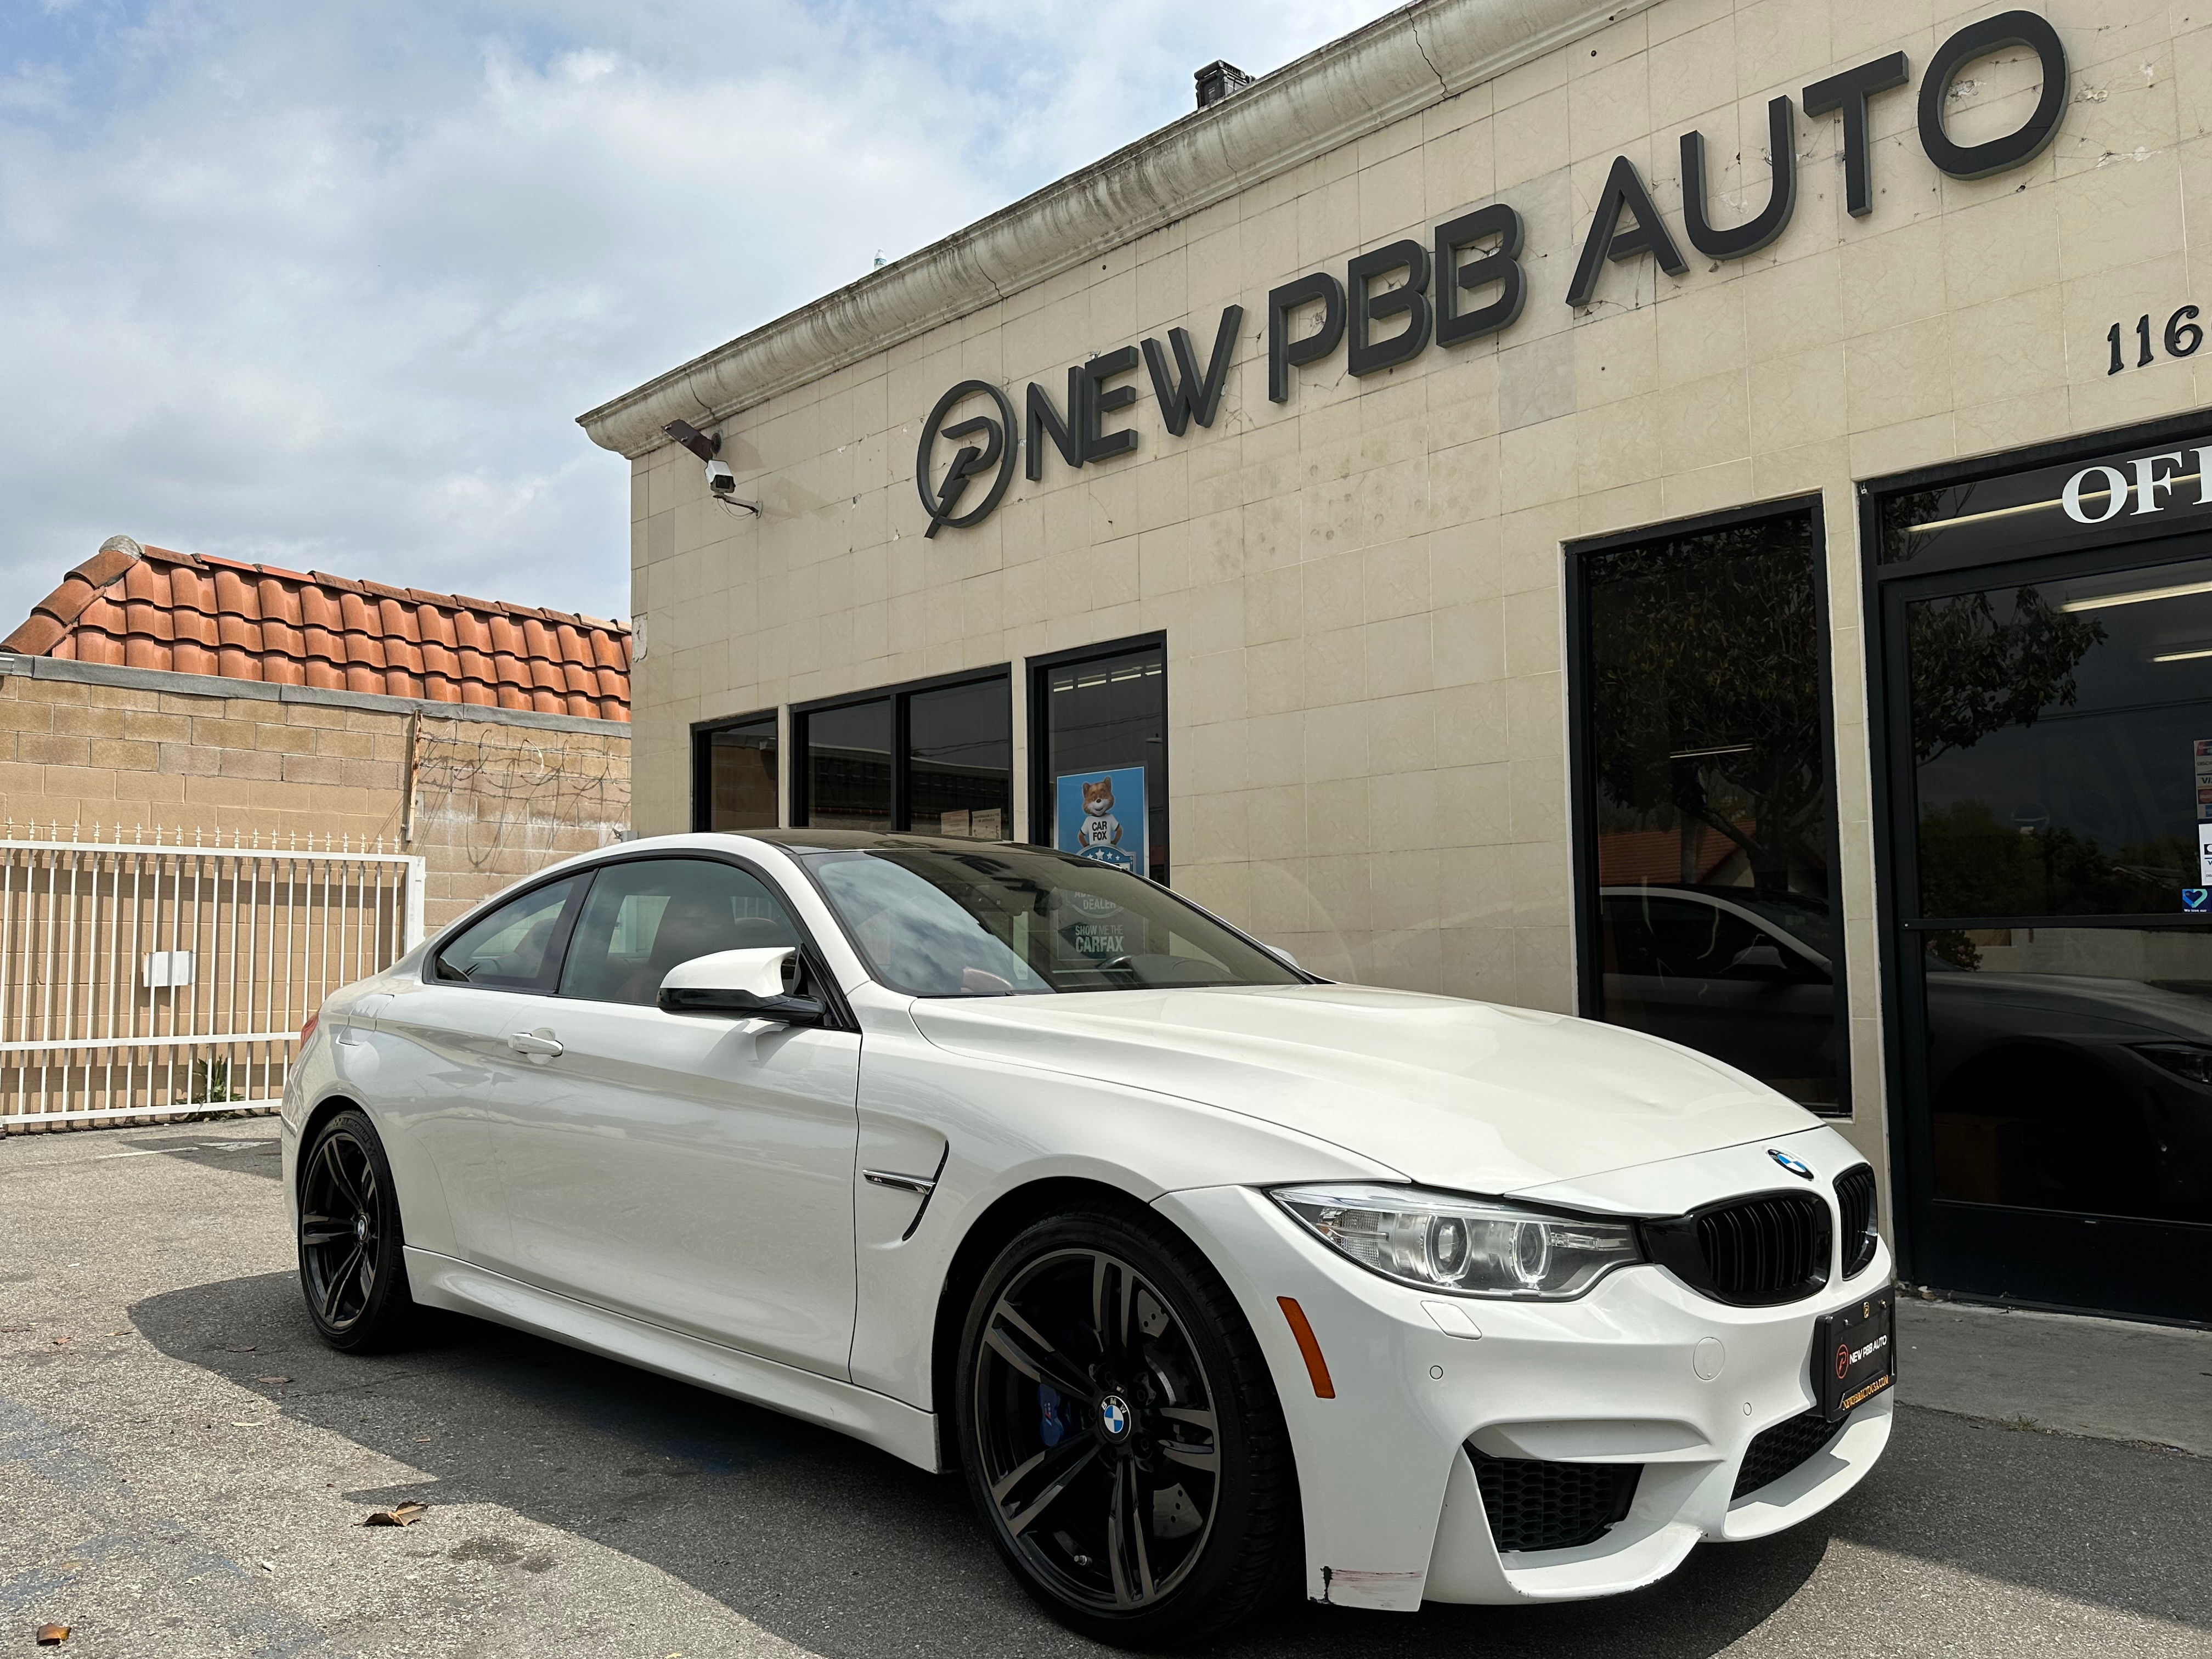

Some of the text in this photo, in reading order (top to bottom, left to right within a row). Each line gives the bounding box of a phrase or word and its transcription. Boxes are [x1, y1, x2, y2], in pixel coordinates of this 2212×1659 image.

[1025, 303, 1244, 481] NEW
[1268, 202, 1527, 403] PBB
[1565, 9, 2070, 308] AUTO
[2107, 304, 2212, 376] 116
[1092, 821, 1107, 832] CAR
[1093, 831, 1107, 841] FOX
[1075, 924, 1124, 935] SHOW ME THE
[1075, 936, 1124, 952] CARFAX
[1849, 1348, 1863, 1364] NEW
[1863, 1342, 1873, 1358] PBB
[1873, 1335, 1887, 1351] AUTO
[1101, 1397, 1127, 1413] BMW
